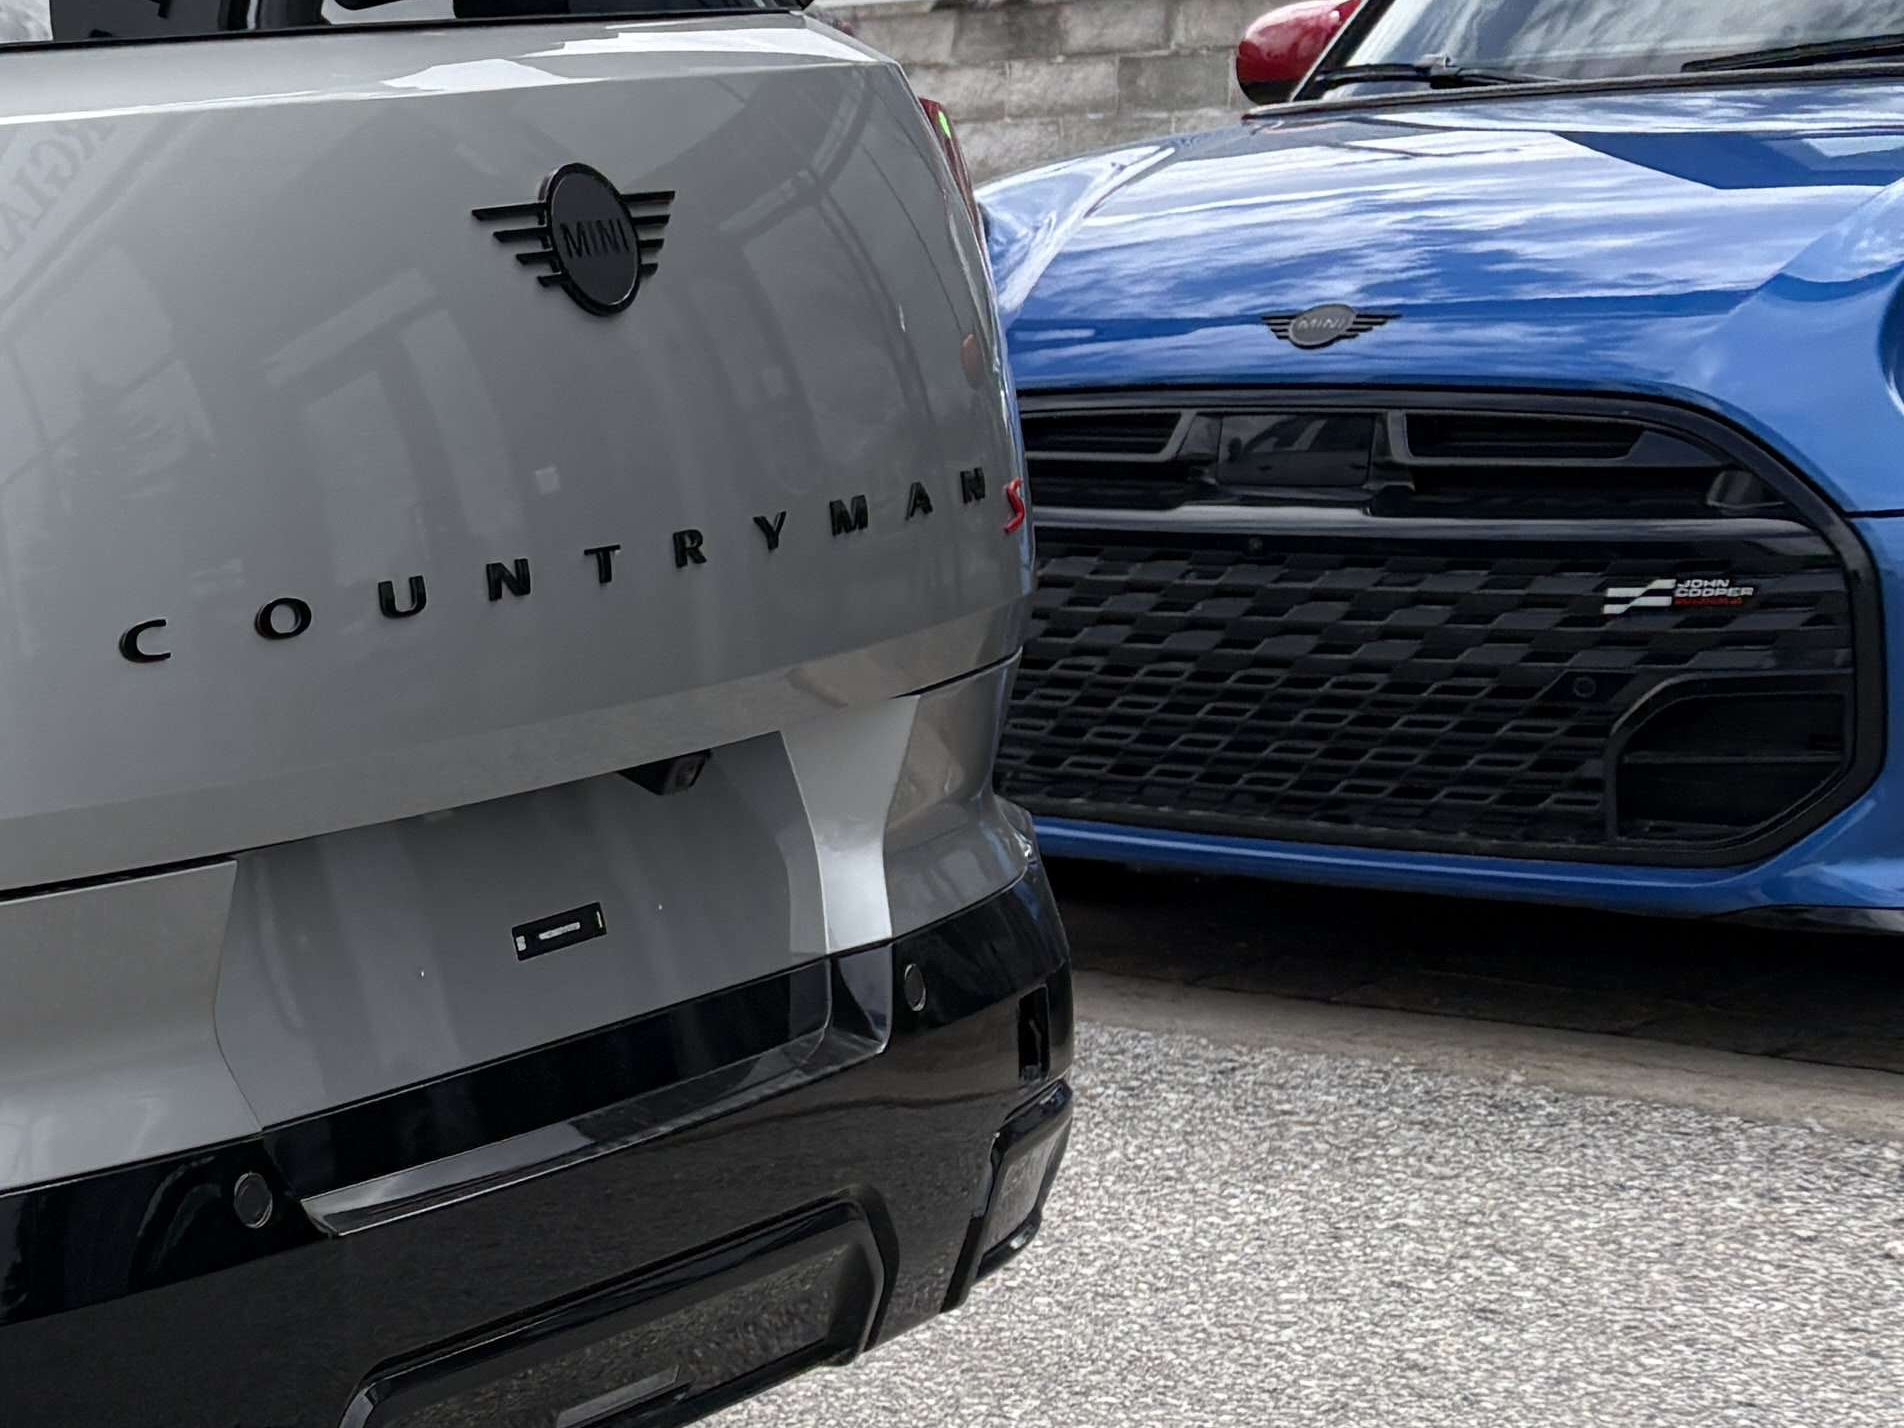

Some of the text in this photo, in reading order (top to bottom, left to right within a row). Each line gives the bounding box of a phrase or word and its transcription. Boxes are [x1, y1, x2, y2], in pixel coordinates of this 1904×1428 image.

[559, 218, 630, 259] MINI
[1296, 314, 1349, 333] MINI
[118, 467, 1027, 664] COUNTRYMAN S
[1674, 587, 1754, 598] COOPER
[1677, 579, 1730, 588] JOHN
